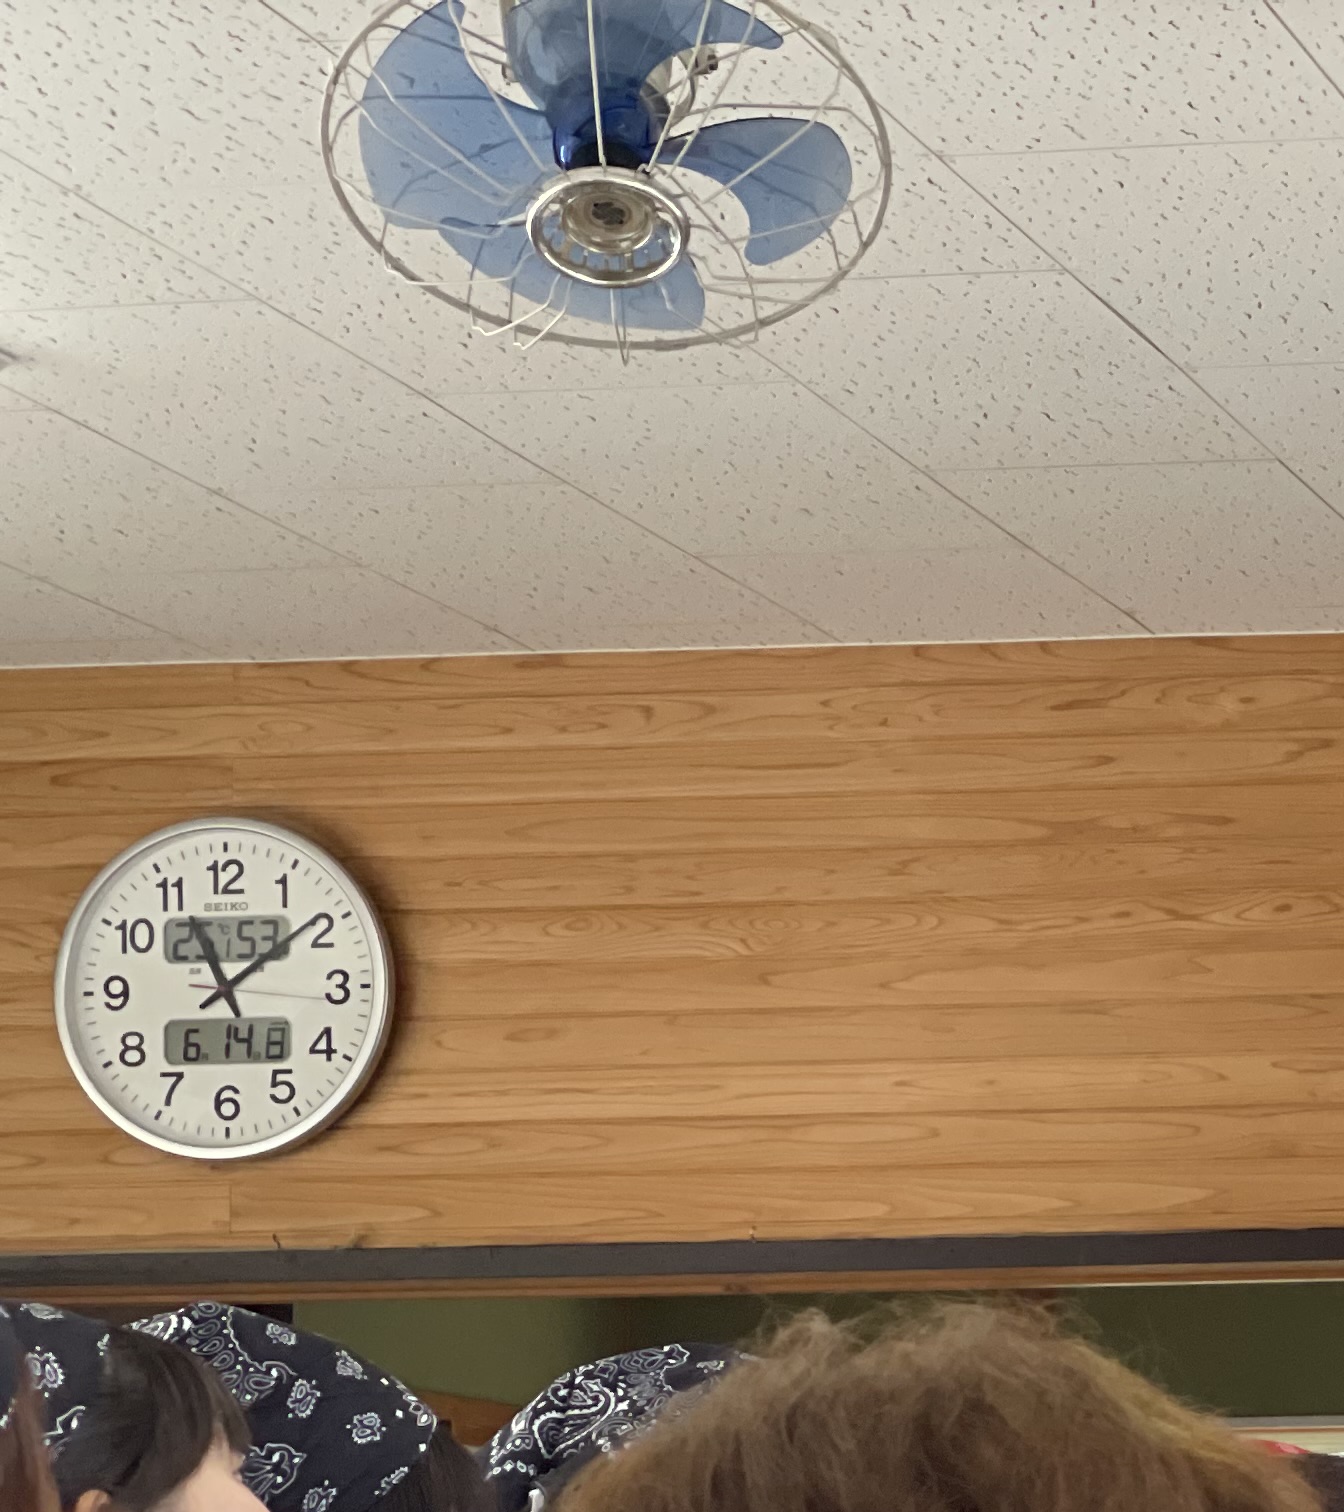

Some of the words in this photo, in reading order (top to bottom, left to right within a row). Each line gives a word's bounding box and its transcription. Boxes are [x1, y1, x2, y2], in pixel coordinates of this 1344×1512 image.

[156, 876, 184, 912] 11
[206, 859, 245, 895] 12
[274, 873, 288, 909] 1
[203, 901, 249, 912] SEIKO
[115, 917, 155, 955] 10
[310, 912, 335, 949] 2
[103, 975, 130, 1011] 9
[324, 968, 351, 1006] 3
[118, 1031, 147, 1067] 8
[308, 1026, 338, 1062] 4
[159, 1071, 185, 1107] 7
[213, 1085, 241, 1121] 6
[269, 1068, 296, 1105] 5
